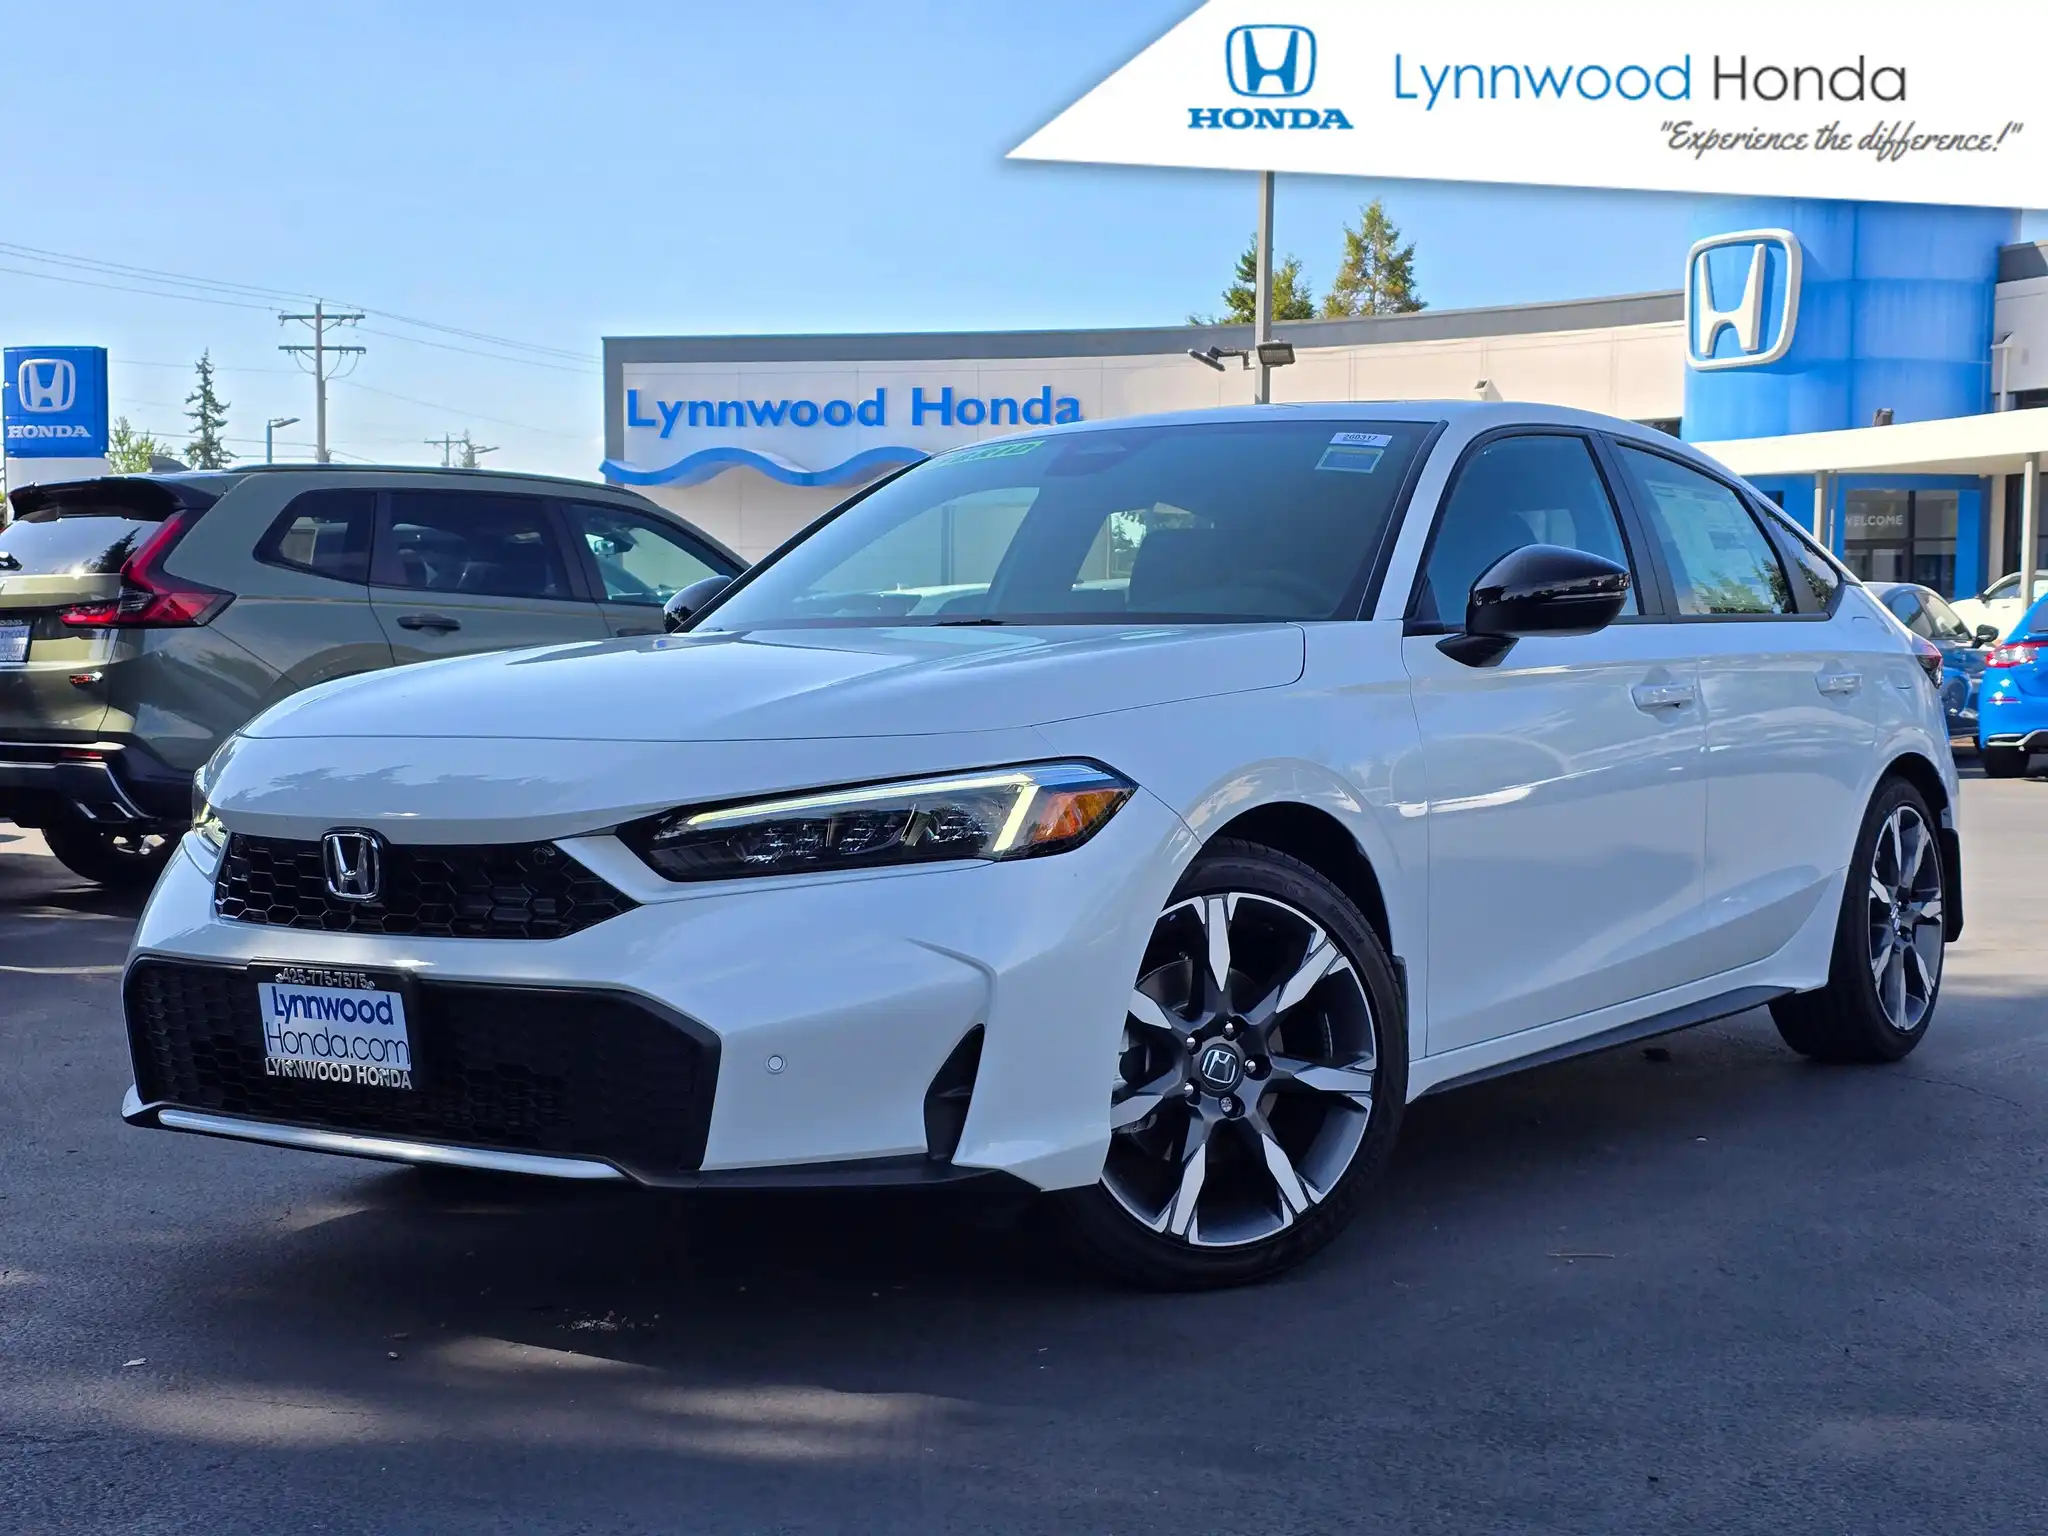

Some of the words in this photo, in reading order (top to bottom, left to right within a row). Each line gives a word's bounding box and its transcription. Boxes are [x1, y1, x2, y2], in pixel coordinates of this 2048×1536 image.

[7, 425, 92, 438] HONDA
[627, 387, 886, 439] Lynnwood
[911, 385, 1083, 426] Honda
[282, 967, 368, 989] 425-775-7575
[271, 985, 395, 1025] Lynnwood
[265, 1021, 411, 1065] Honda.com
